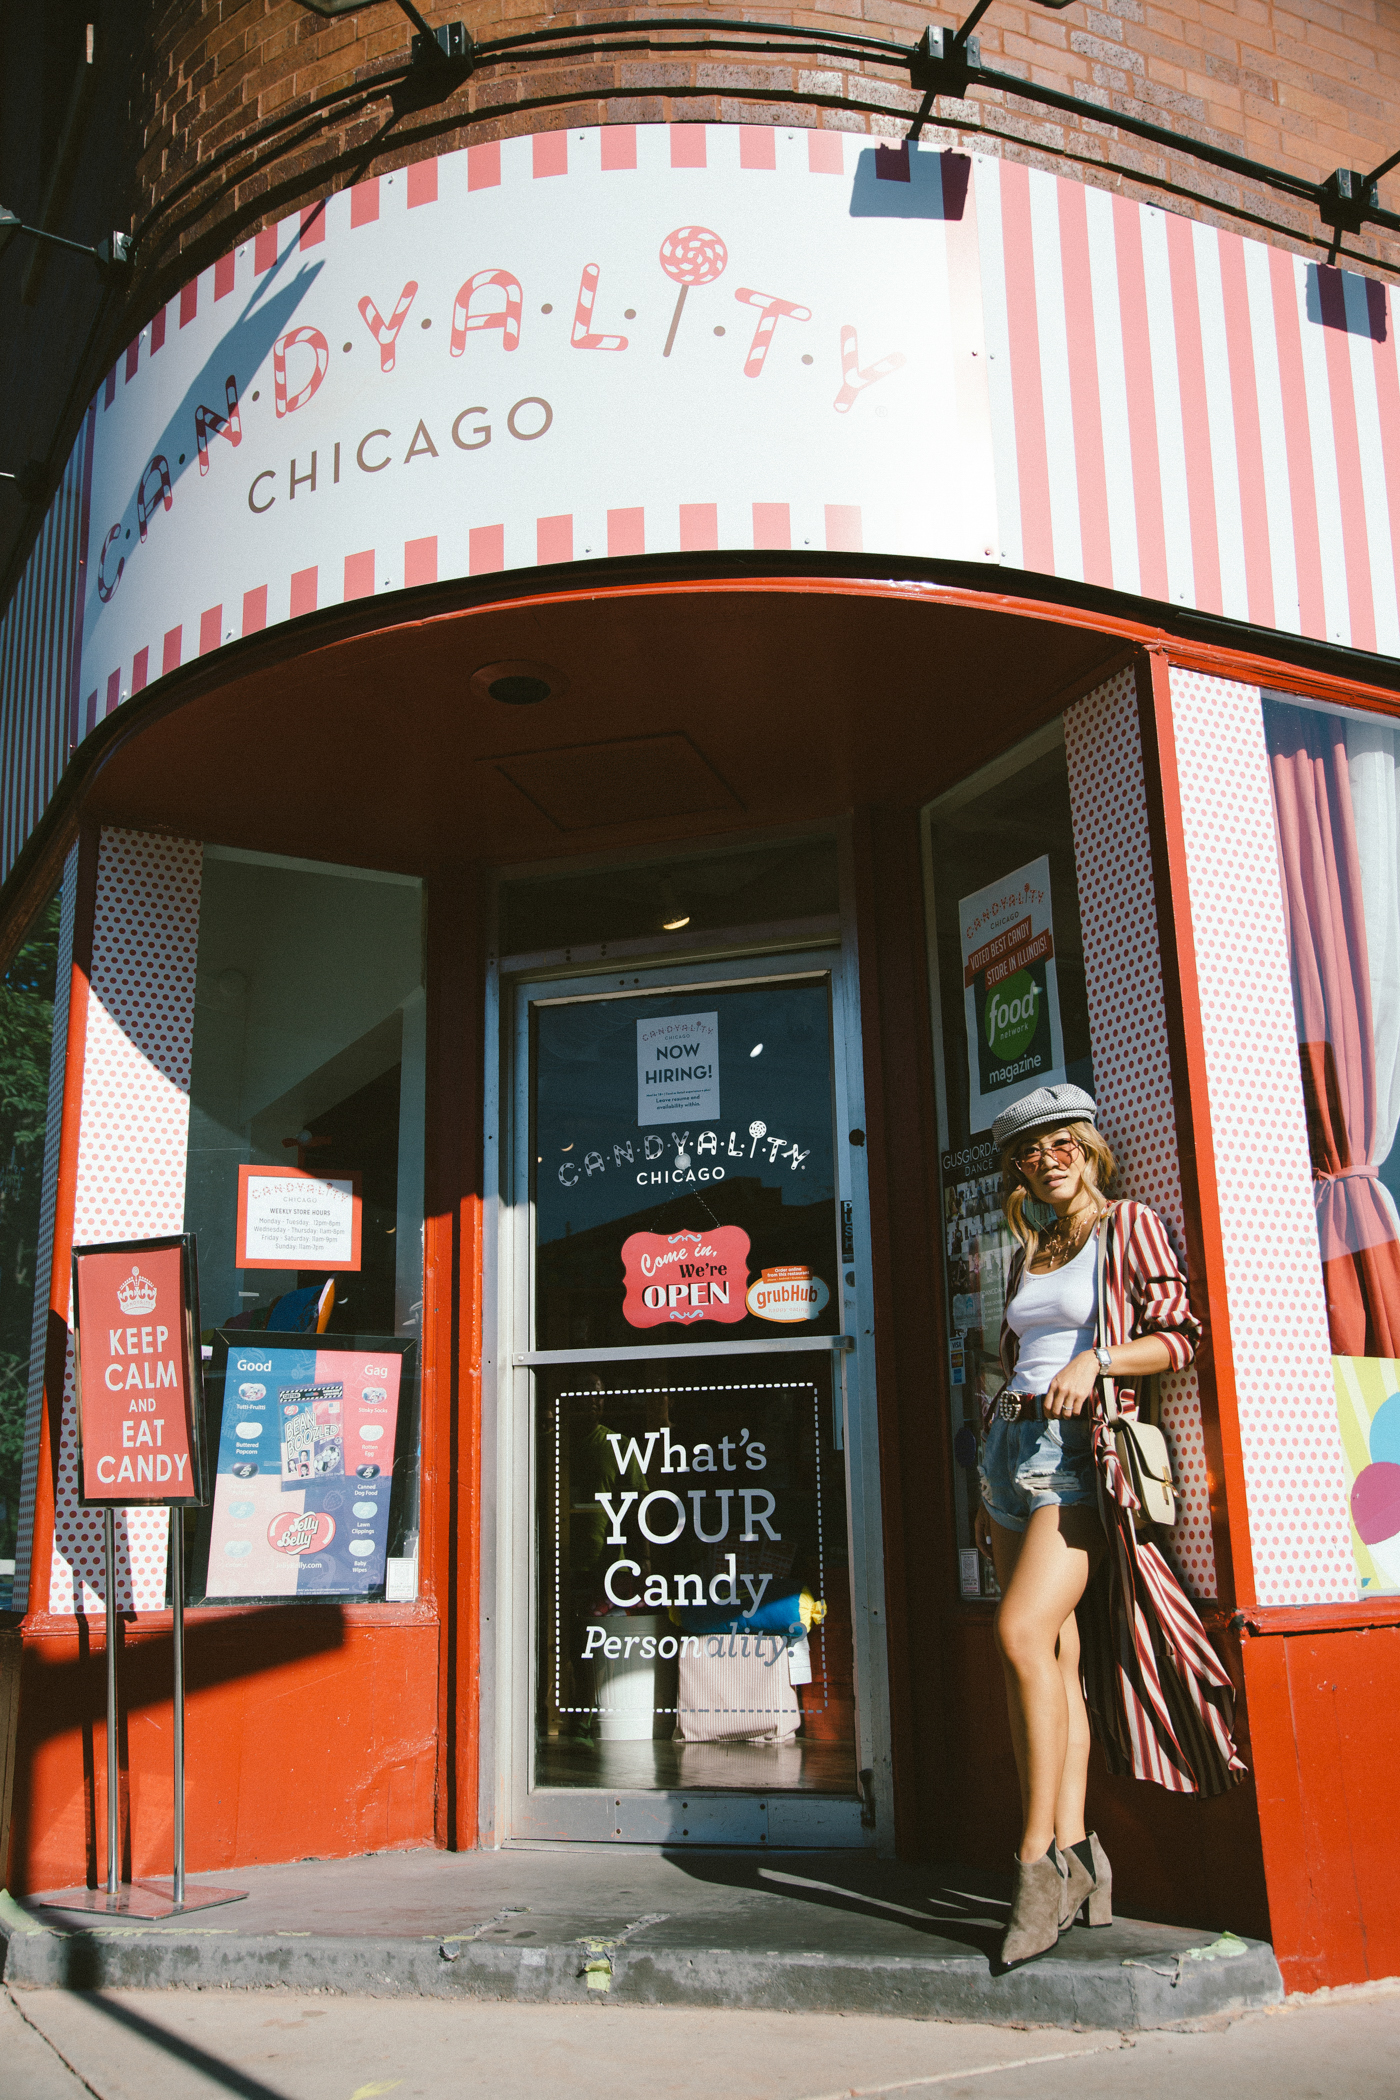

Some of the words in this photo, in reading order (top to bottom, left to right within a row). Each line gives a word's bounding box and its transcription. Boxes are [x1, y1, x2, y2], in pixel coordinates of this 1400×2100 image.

[247, 396, 554, 514] CHICAGO
[990, 911, 1020, 930] CHICAGO
[970, 946, 990, 971] VOTED
[990, 936, 1008, 960] BEST
[1008, 919, 1031, 948] CANDY
[986, 962, 1008, 986] STORE
[1008, 958, 1017, 972] IN
[1017, 940, 1048, 969] ILLINOIS!
[988, 980, 1035, 1047] food
[1000, 1023, 1029, 1041] network
[656, 1042, 700, 1060] NOW
[645, 1065, 712, 1084] HIRING!
[989, 1053, 1041, 1084] magazine
[636, 1166, 725, 1186] CHICAGO
[964, 1158, 993, 1177] DANCE
[283, 1196, 318, 1204] CHICAGO
[254, 1226, 286, 1234] Wednesday
[259, 1218, 281, 1226] Monday
[261, 1234, 279, 1242] Friday
[640, 1247, 689, 1277] Come
[694, 1242, 717, 1258] in,
[679, 1263, 727, 1278] We're
[642, 1281, 730, 1309] OPEN
[756, 1285, 818, 1309] grubHub
[109, 1326, 169, 1356] KEEP
[952, 1341, 962, 1349] VISA
[105, 1360, 178, 1391] CALM
[237, 1359, 272, 1372] Good
[364, 1364, 388, 1378] Gag
[129, 1398, 156, 1413] AND
[122, 1419, 165, 1448] EAT
[284, 1406, 317, 1442] BEAN
[287, 1424, 339, 1461] BOOZLED
[606, 1426, 768, 1475] What's
[97, 1453, 188, 1484] CANDY
[289, 1516, 320, 1534] Jelly
[595, 1488, 782, 1545] YOUR
[277, 1531, 312, 1548] Belly
[604, 1553, 774, 1618] Candy
[581, 1621, 808, 1667] Personality?
